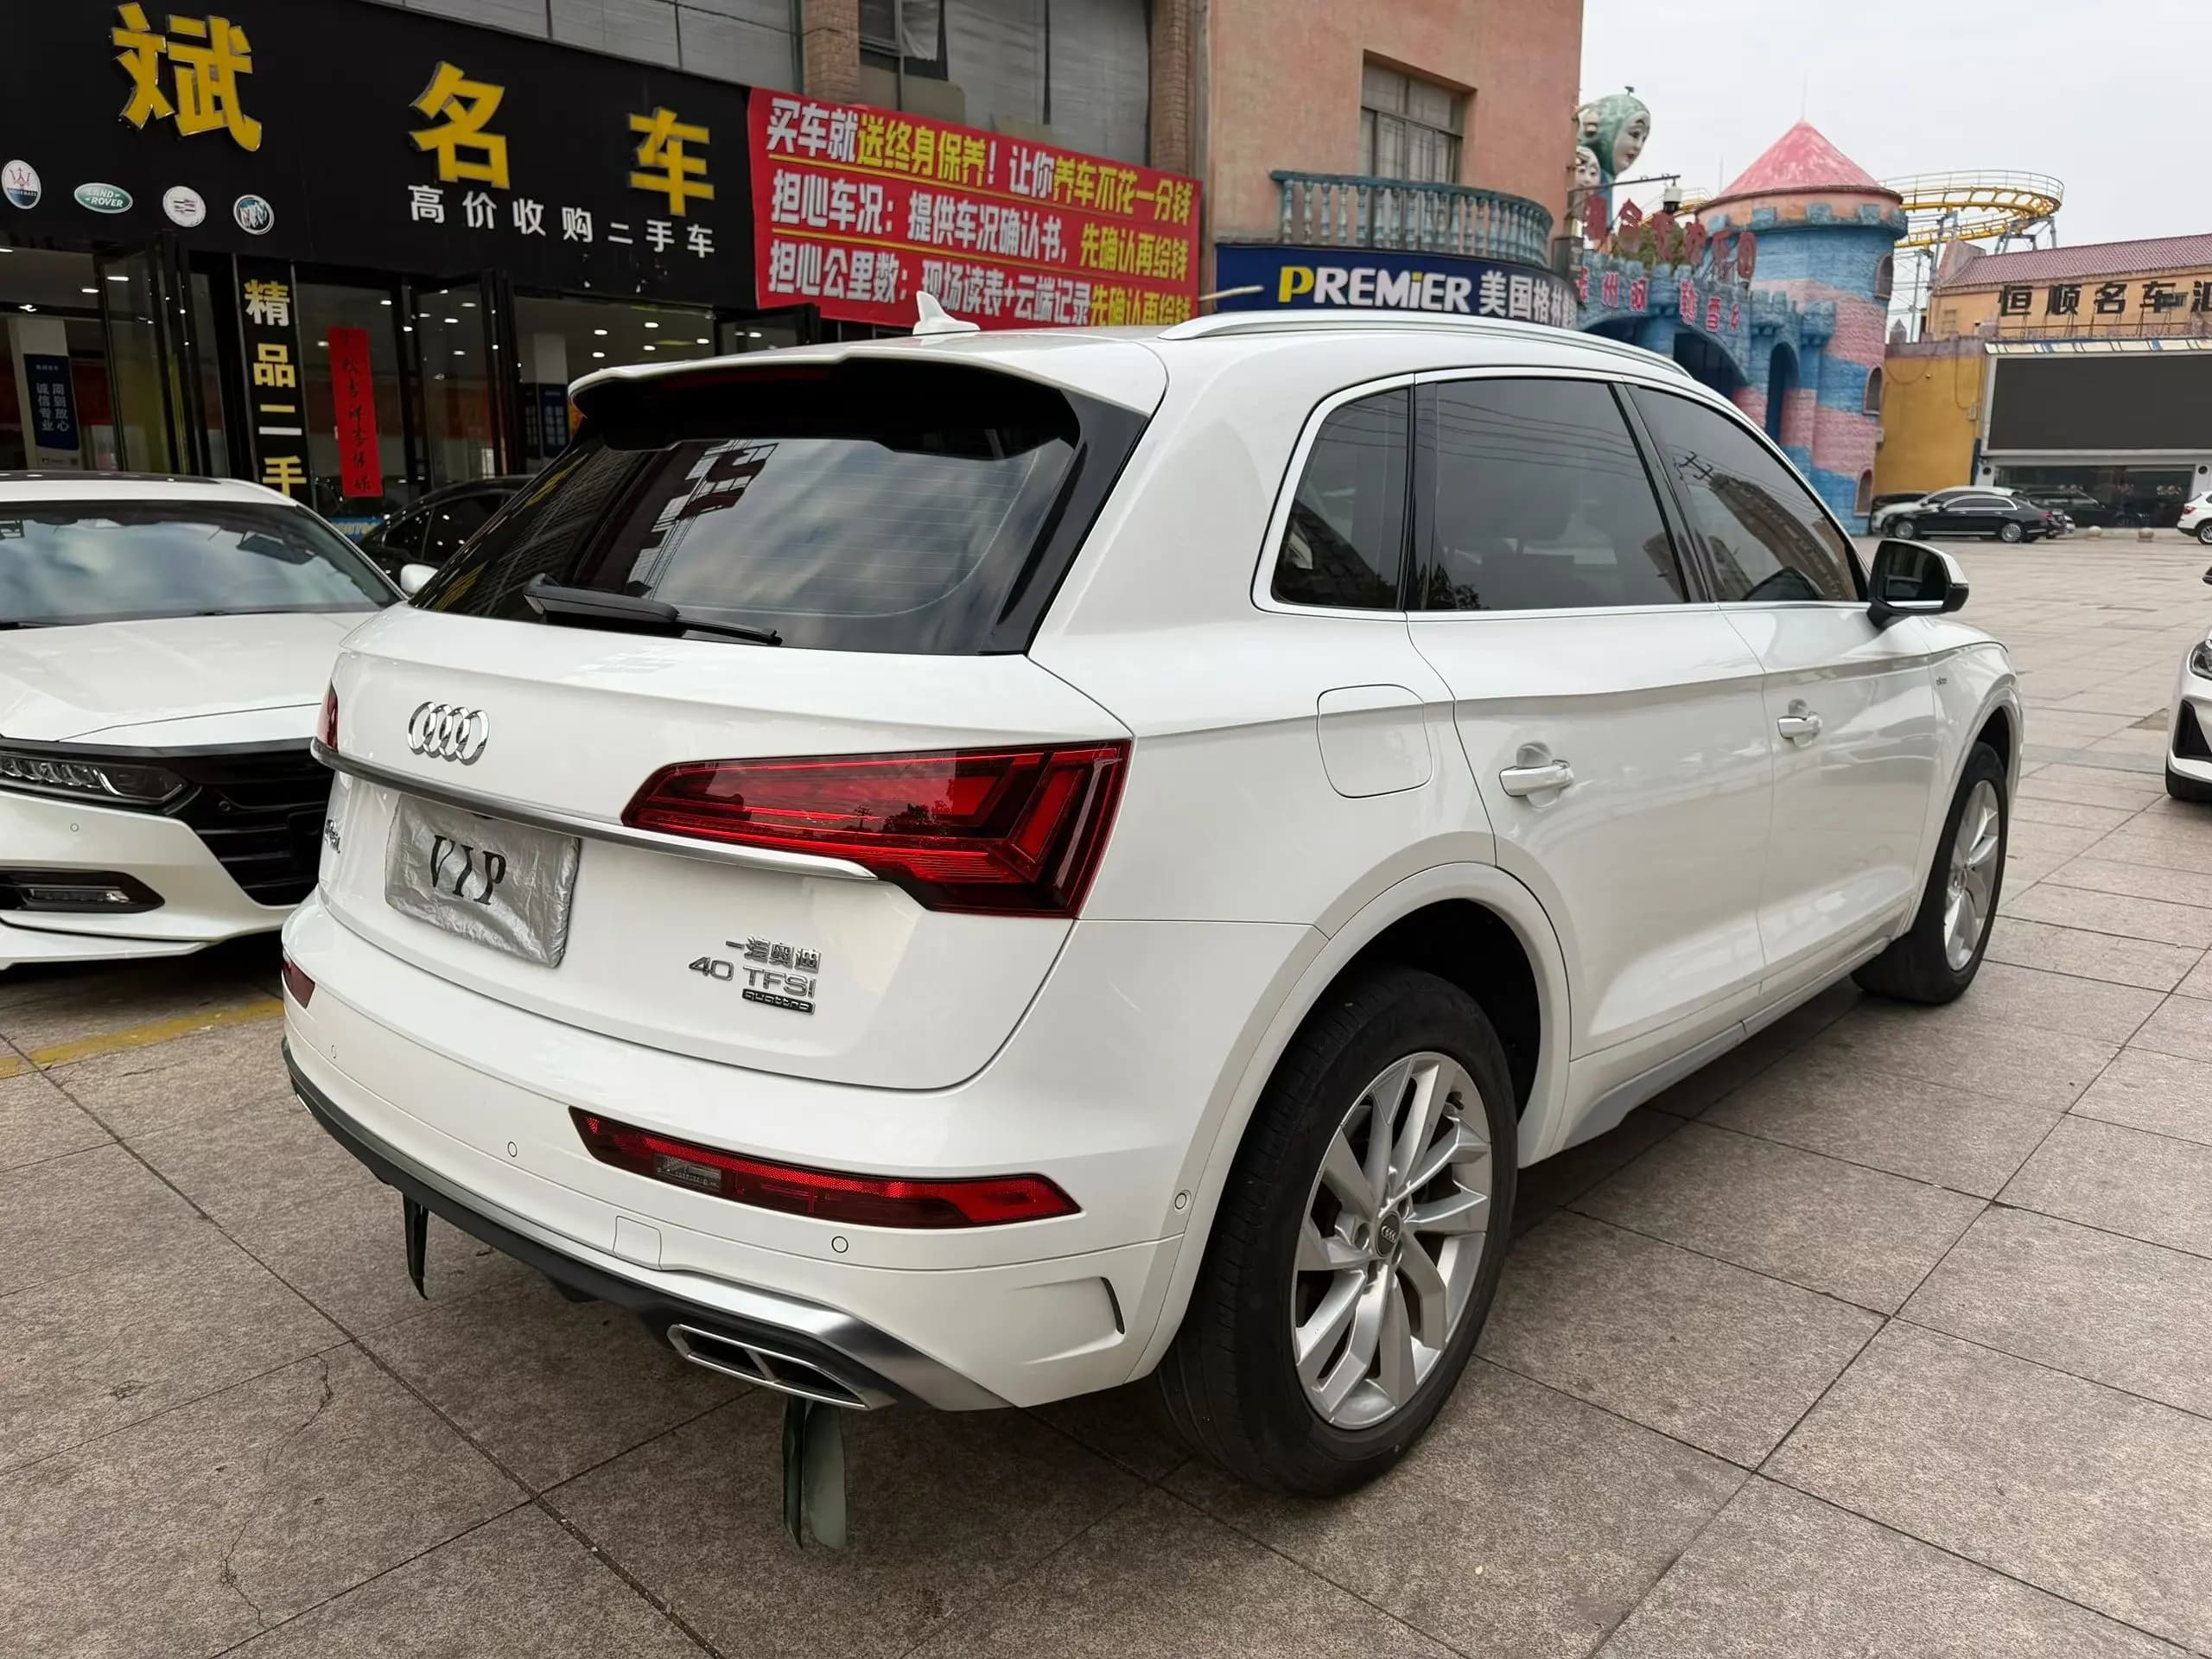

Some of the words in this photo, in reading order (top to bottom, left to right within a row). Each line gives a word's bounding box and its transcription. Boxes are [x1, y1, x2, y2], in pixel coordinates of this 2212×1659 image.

[87, 188, 114, 199] LAND
[91, 196, 124, 208] ROVER
[407, 184, 715, 258] 高价收购二手车
[244, 278, 308, 498] 精品二手
[430, 833, 506, 906] VIP
[689, 956, 735, 982] 40
[742, 965, 817, 999] TFSI
[743, 989, 813, 1013] quattro
